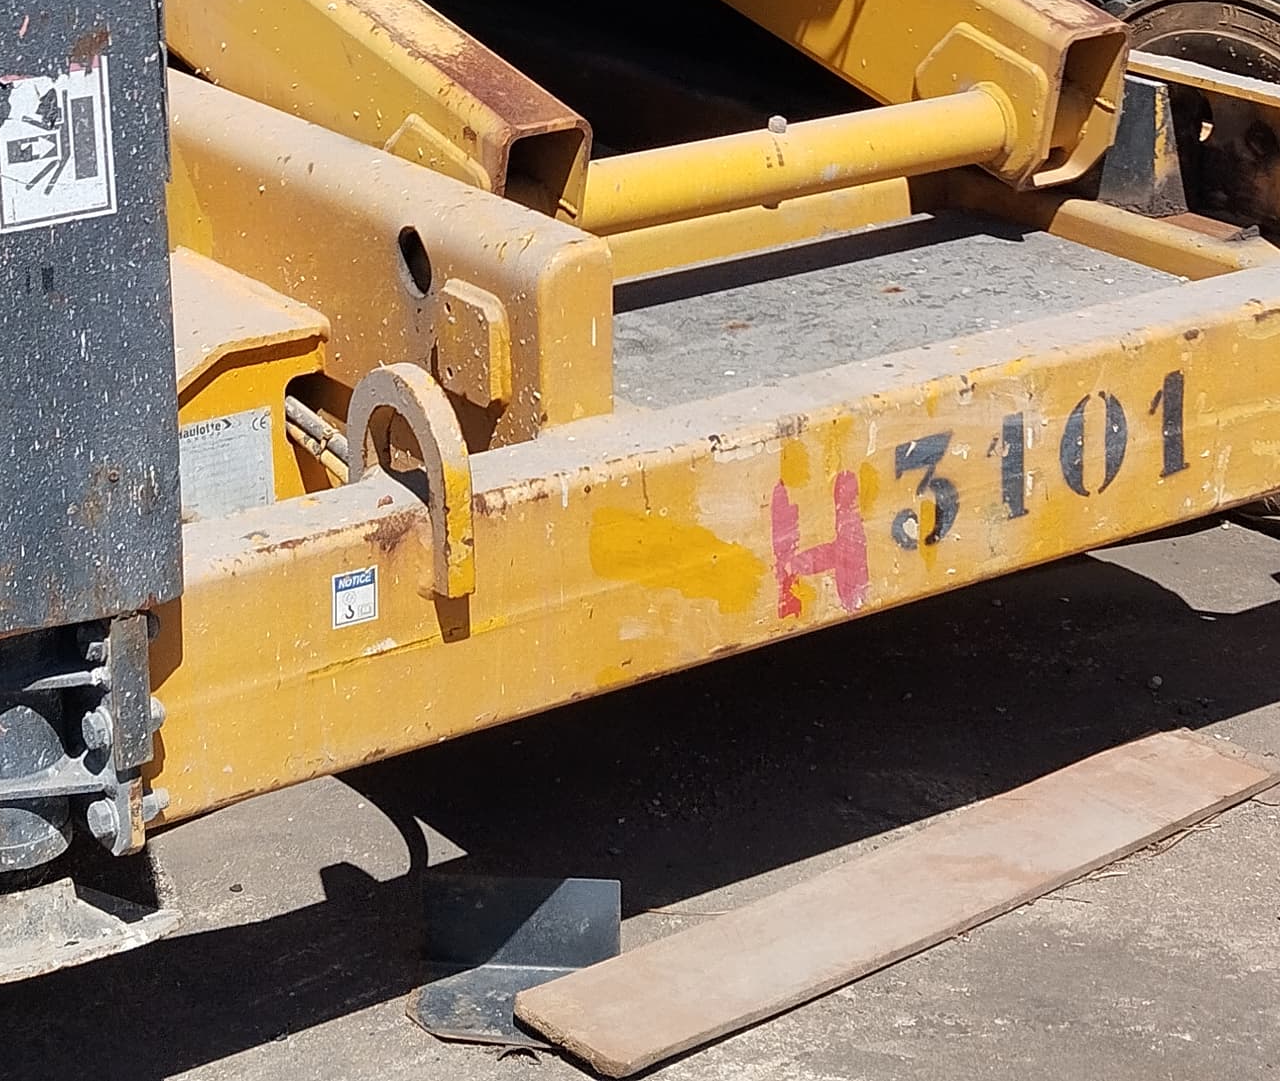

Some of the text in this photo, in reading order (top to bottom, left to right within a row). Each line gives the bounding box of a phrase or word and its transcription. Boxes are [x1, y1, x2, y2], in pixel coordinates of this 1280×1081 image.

[770, 369, 1189, 620] H 3101
[337, 571, 373, 589] NOTICE
